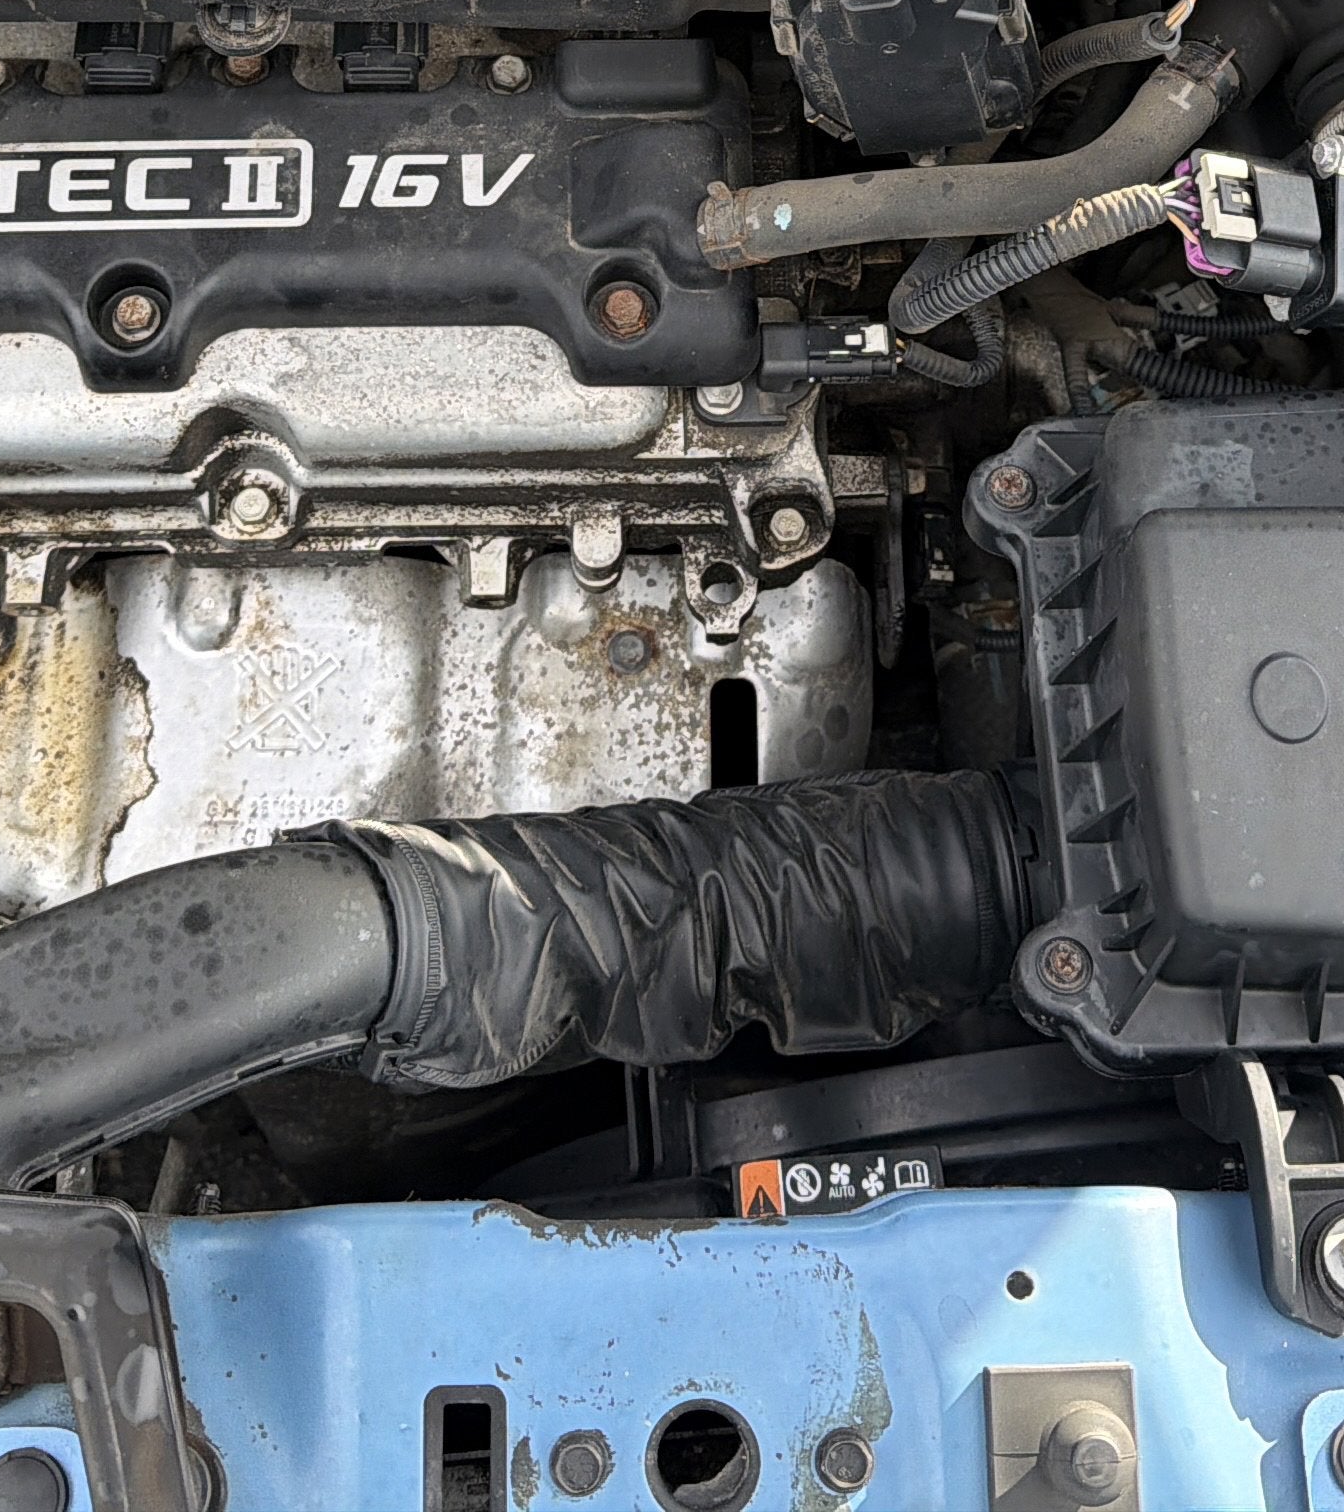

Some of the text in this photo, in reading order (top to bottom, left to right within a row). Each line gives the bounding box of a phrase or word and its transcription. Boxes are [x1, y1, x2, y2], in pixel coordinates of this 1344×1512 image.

[222, 154, 286, 211] II
[338, 152, 536, 208] 16V
[829, 1185, 855, 1200] AUTO
